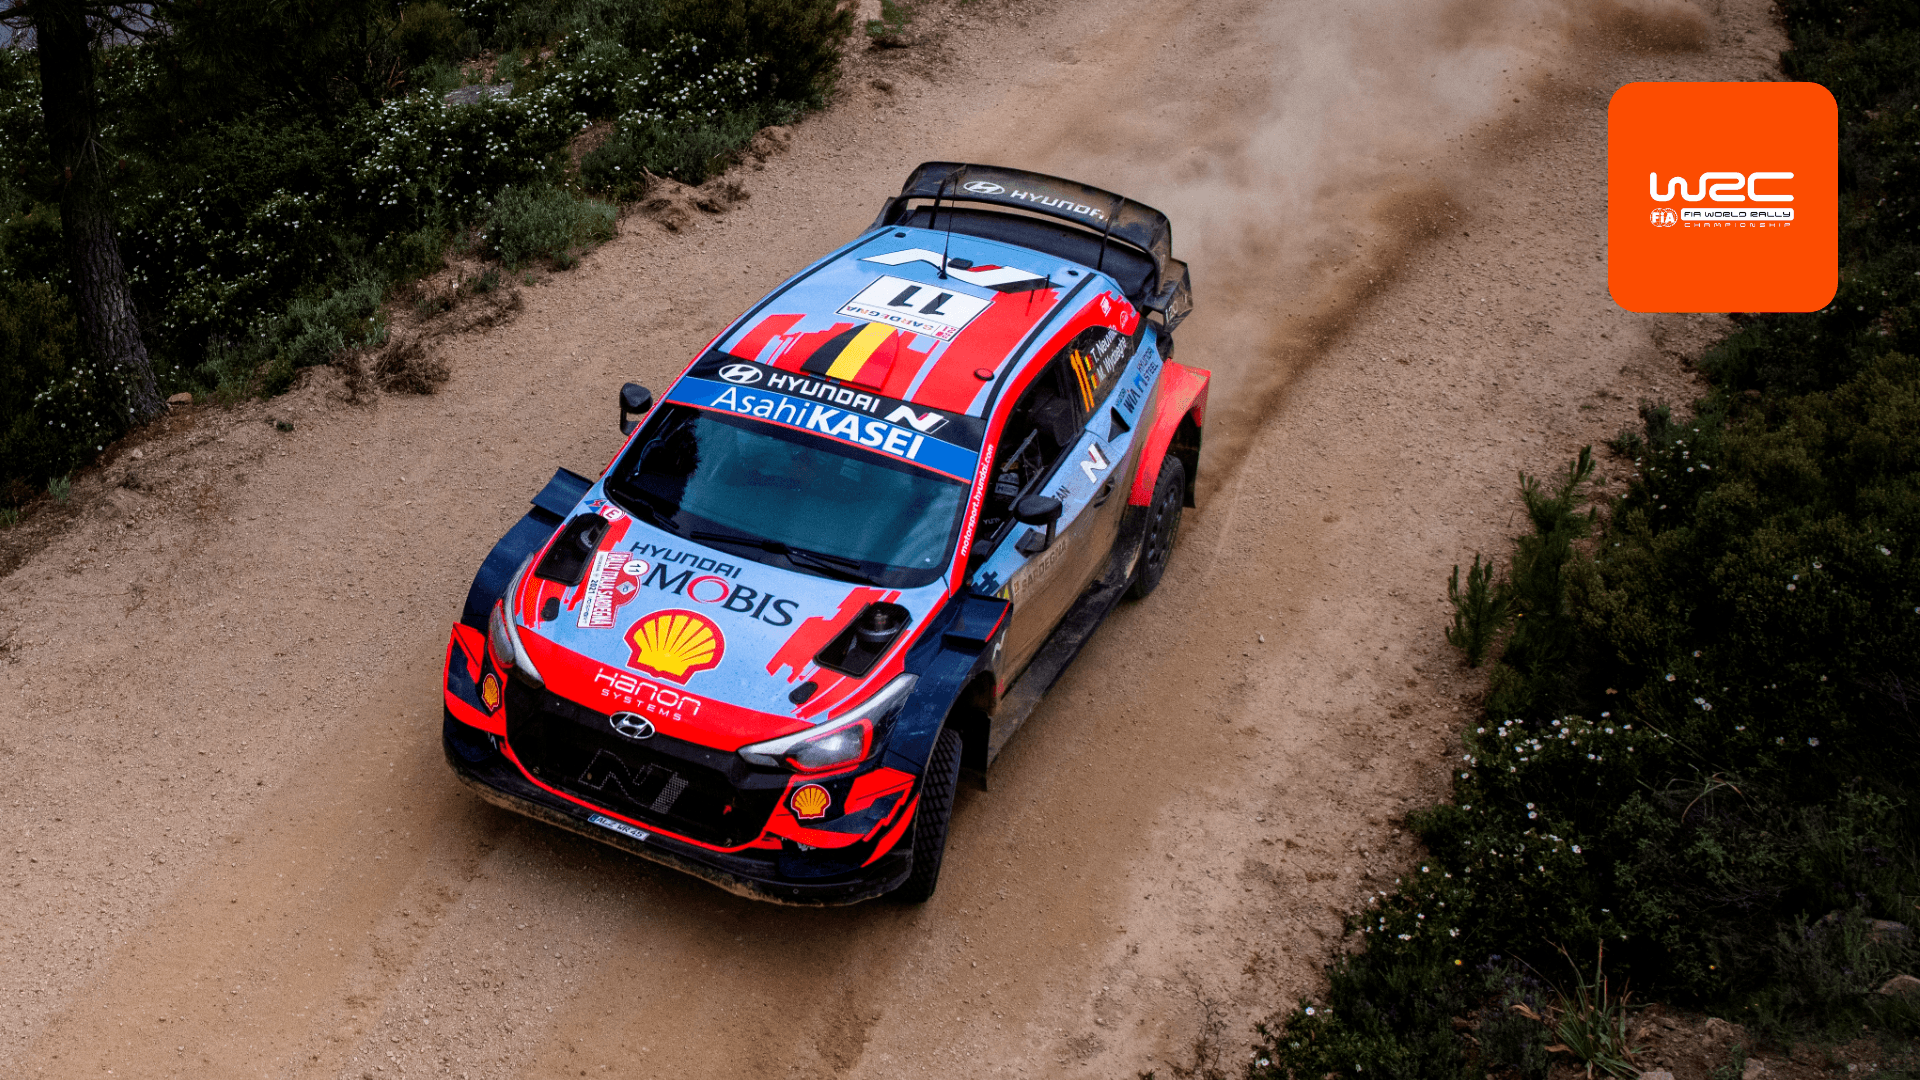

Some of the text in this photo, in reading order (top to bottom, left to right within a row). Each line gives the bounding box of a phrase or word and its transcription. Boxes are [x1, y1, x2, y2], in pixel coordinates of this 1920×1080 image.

[887, 284, 954, 316] 11
[766, 372, 881, 413] HYUNDAI
[960, 443, 995, 557] motorsport.hyundai.com
[629, 541, 743, 579] HYUNDAI
[642, 562, 800, 627] MOBIS
[601, 688, 682, 722] SYSTEMS
